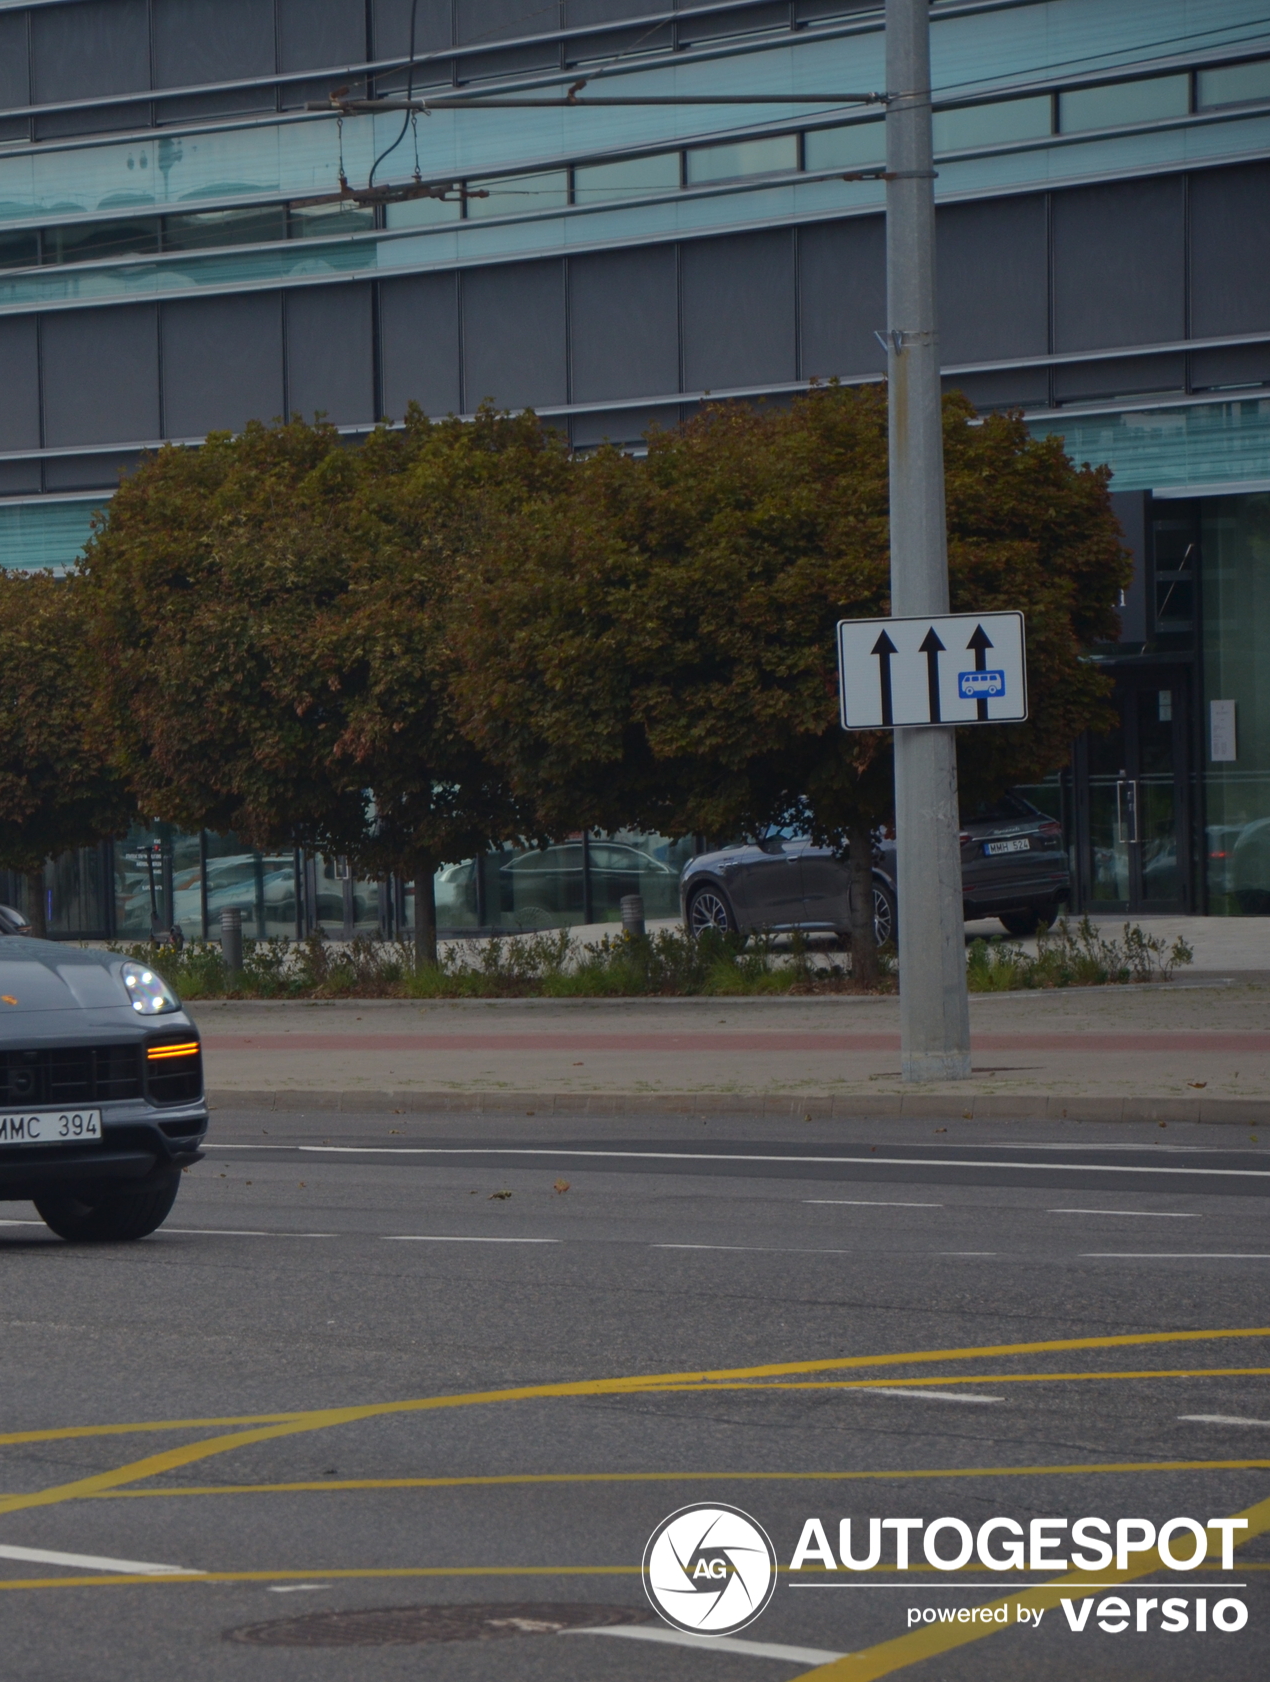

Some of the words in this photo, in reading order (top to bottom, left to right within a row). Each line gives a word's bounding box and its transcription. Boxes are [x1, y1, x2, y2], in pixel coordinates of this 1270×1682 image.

[990, 843, 1009, 853] MMH
[1012, 840, 1028, 850] 524
[59, 1113, 97, 1137] 394
